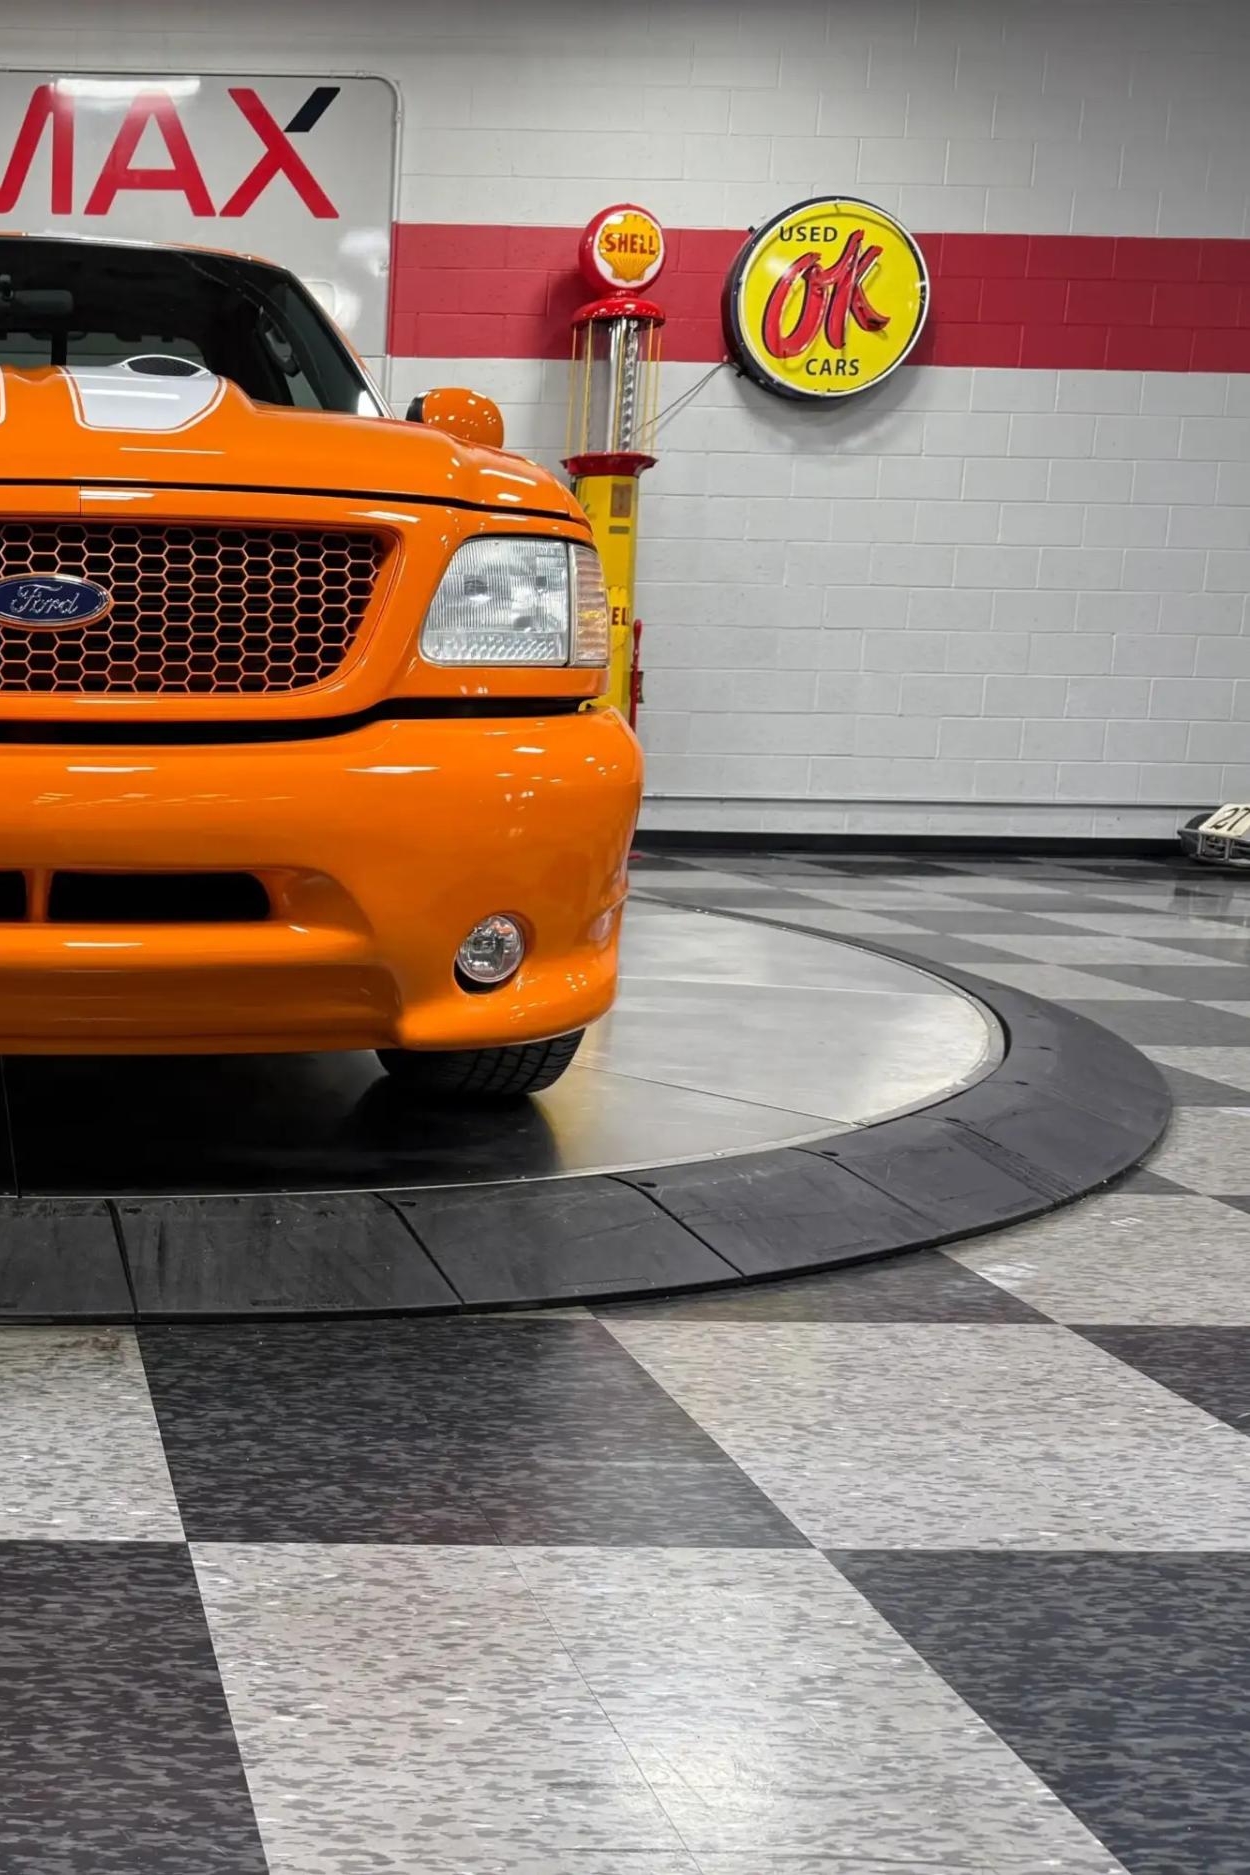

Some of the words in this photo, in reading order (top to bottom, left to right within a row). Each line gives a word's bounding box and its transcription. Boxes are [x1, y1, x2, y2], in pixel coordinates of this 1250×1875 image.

[604, 232, 656, 255] SHELL
[779, 226, 838, 243] USED
[762, 229, 891, 359] OK
[805, 357, 860, 377] CARS
[10, 583, 81, 615] Ford
